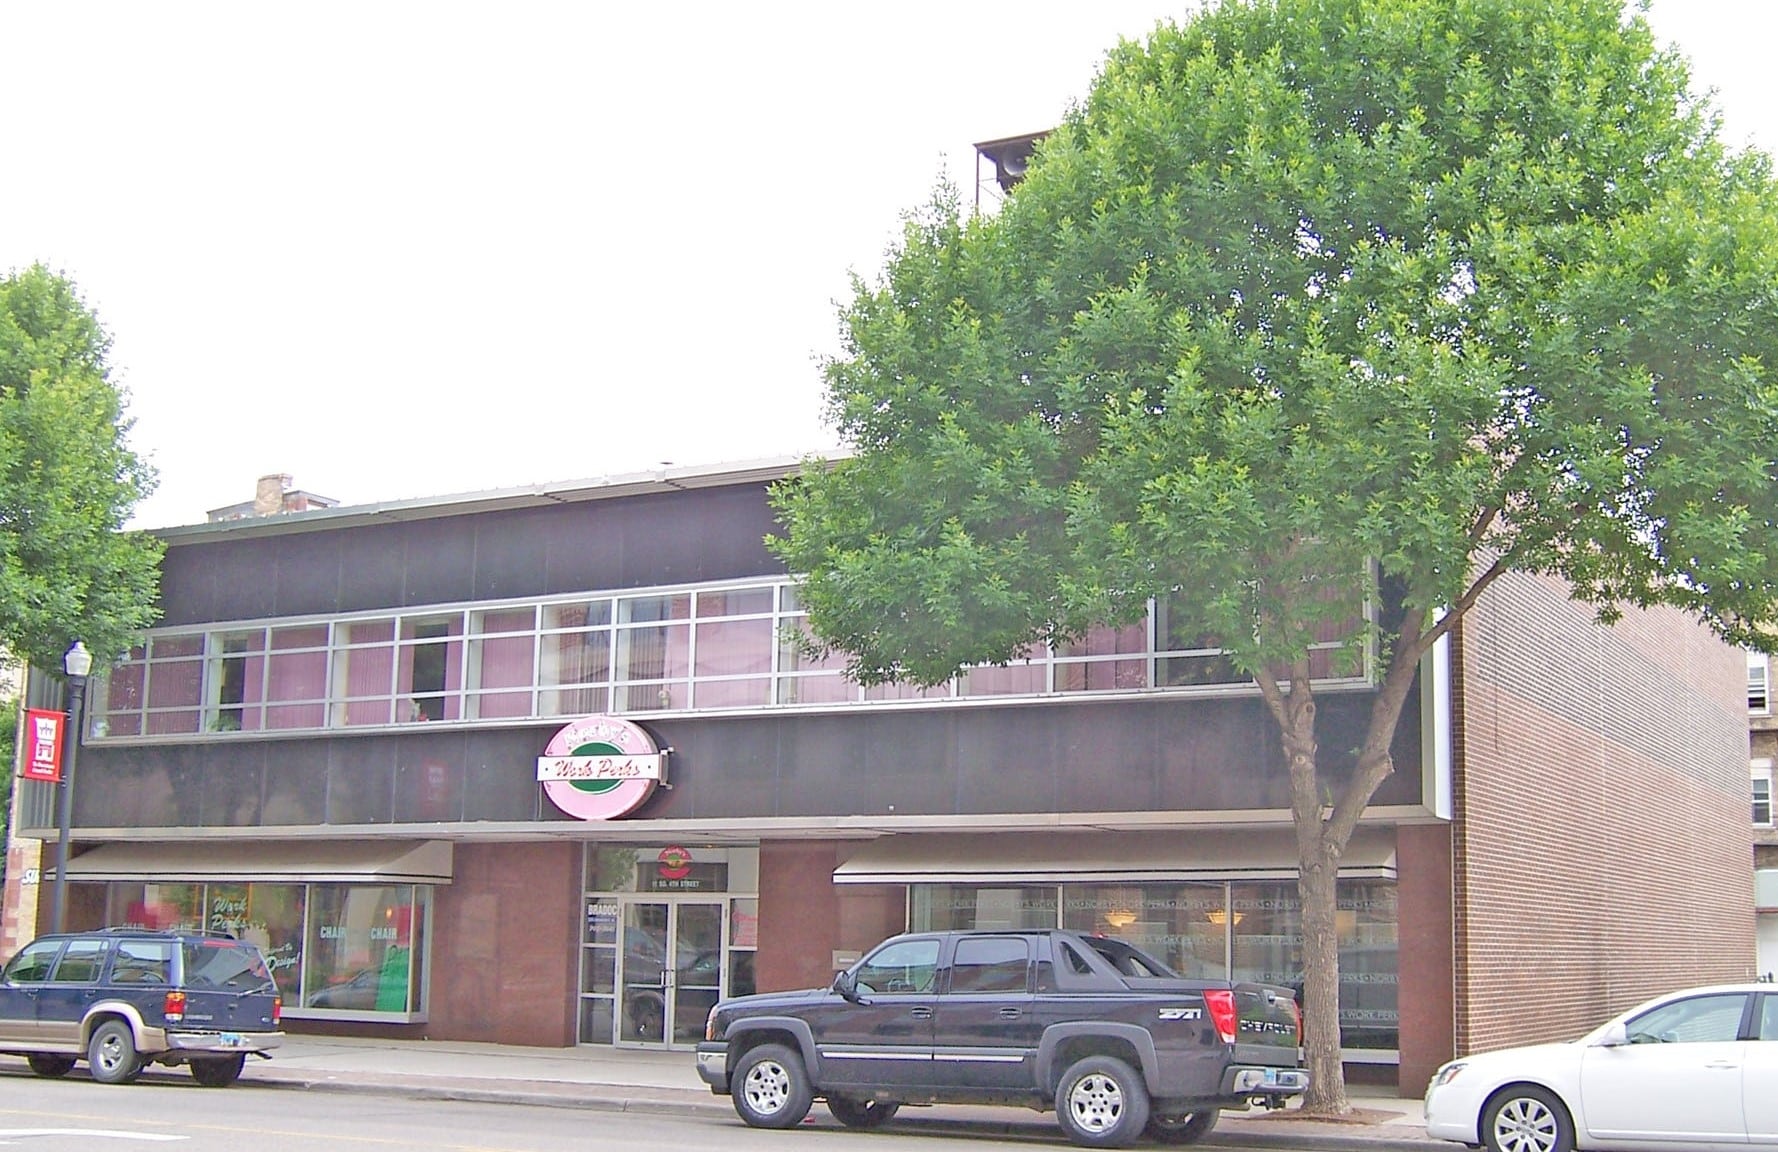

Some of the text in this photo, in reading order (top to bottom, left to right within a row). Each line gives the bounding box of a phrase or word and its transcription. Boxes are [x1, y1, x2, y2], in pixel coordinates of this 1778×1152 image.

[555, 757, 640, 778] Work Perks
[680, 880, 700, 888] STREET
[214, 896, 248, 915] Work
[321, 926, 347, 939] CHAIR
[371, 927, 398, 940] CHAIR
